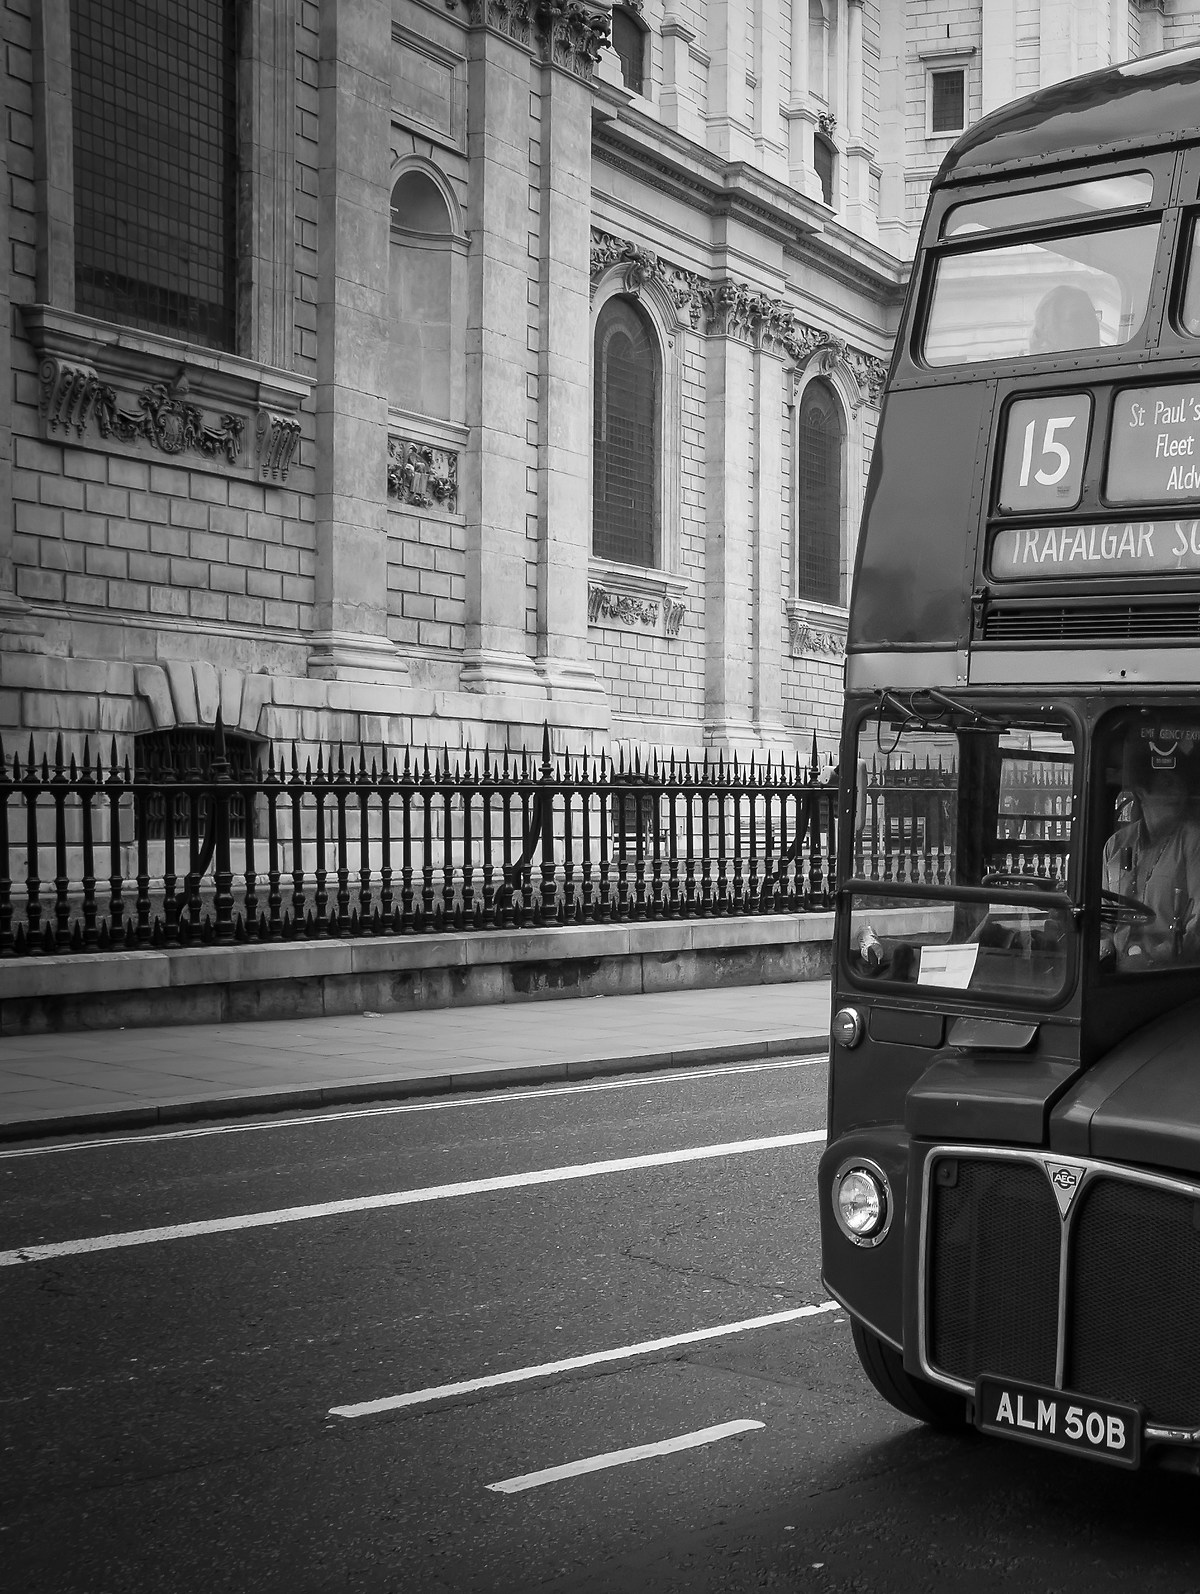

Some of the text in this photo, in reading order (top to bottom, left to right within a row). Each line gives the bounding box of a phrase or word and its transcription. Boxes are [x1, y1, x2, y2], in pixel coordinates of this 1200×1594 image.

[1129, 403, 1145, 427] St
[1019, 416, 1076, 487] 15
[1155, 434, 1194, 458] Fleet
[1054, 1173, 1076, 1185] AEC
[996, 1392, 1126, 1450] ALM 50B
